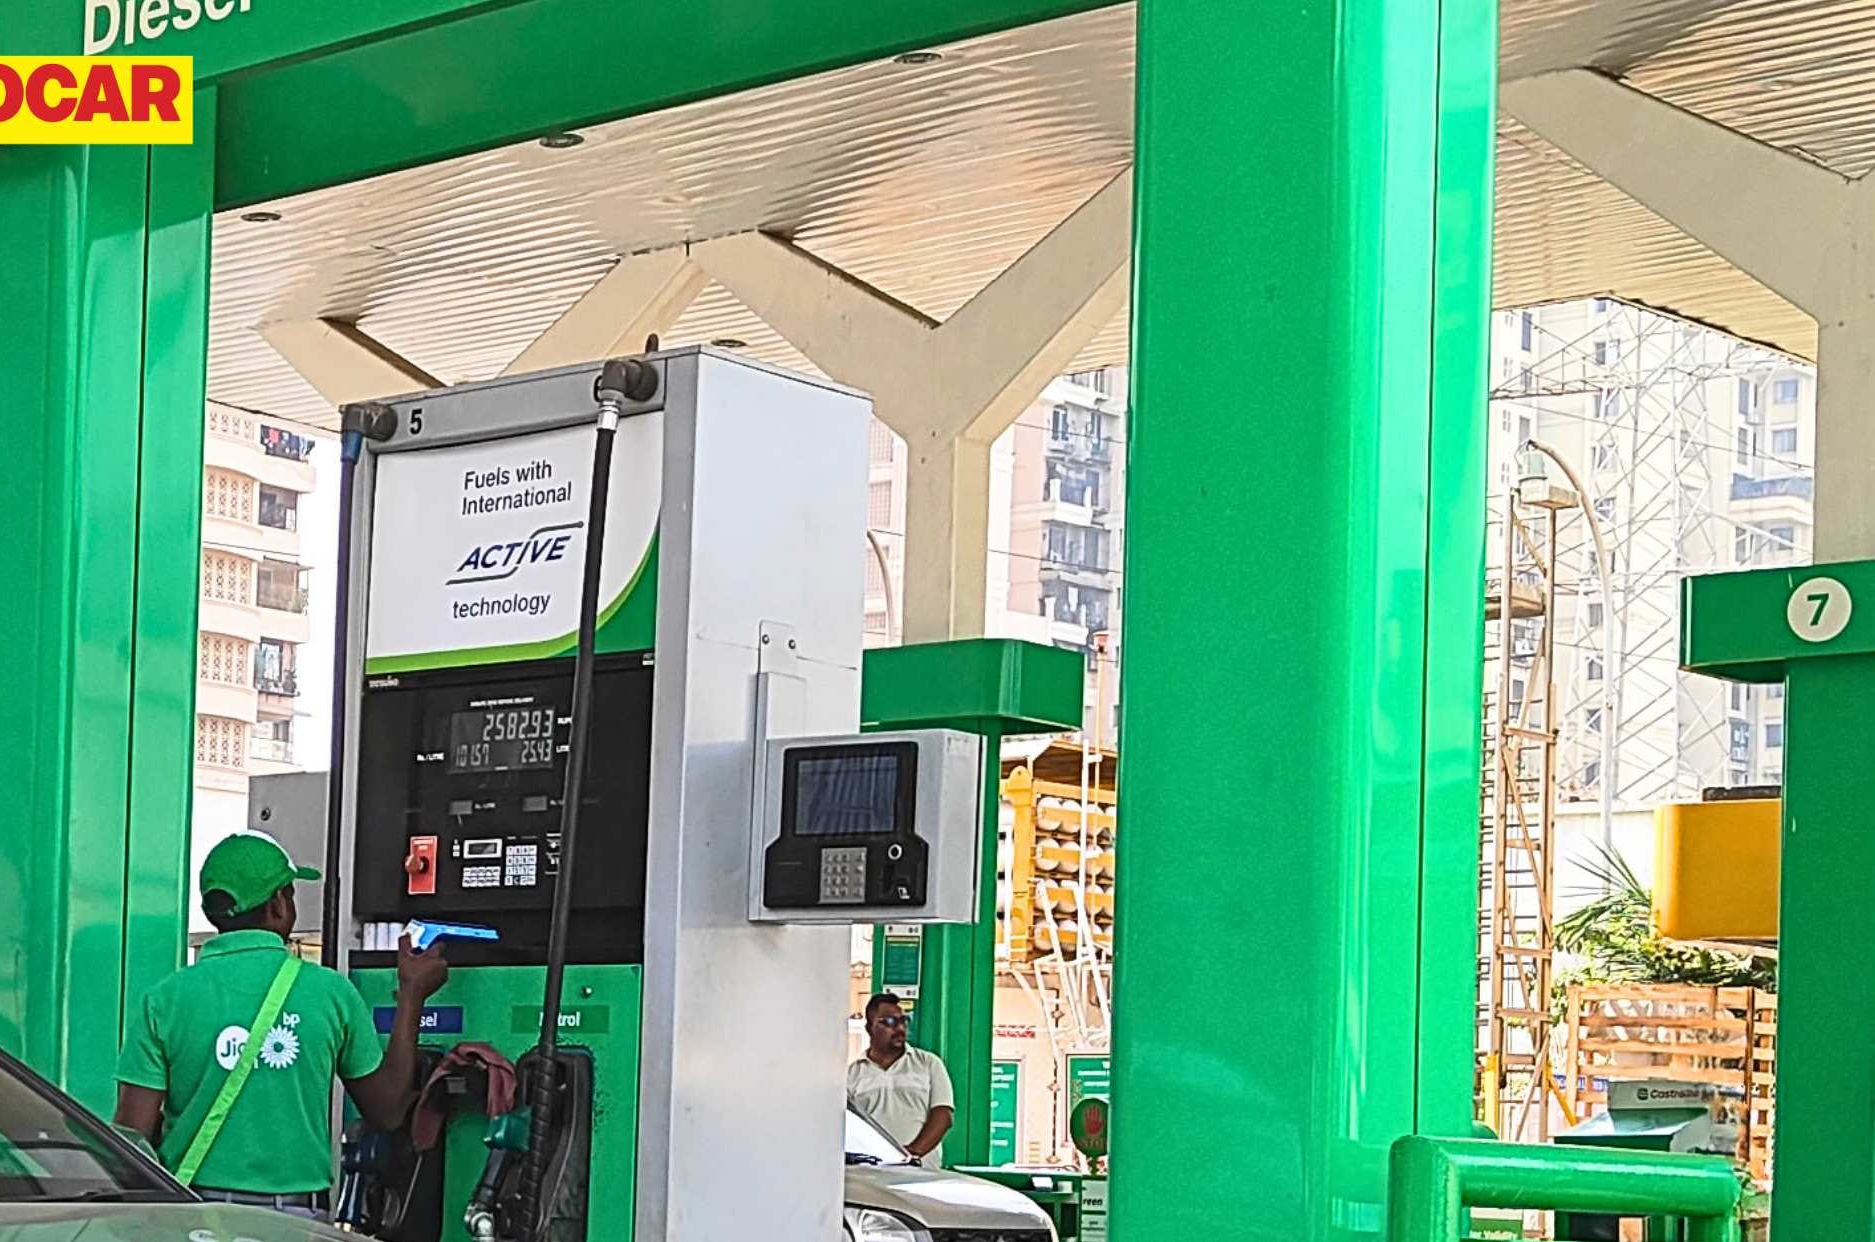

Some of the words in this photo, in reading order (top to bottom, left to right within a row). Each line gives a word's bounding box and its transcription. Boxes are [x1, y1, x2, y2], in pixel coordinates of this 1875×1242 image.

[410, 408, 423, 435] 5
[464, 466, 510, 490] Fuels
[516, 459, 552, 483] with
[462, 481, 572, 515] International
[456, 536, 572, 572] ACTIVE
[453, 593, 551, 619] technology
[1807, 593, 1829, 626] 7
[283, 1011, 301, 1028] bp
